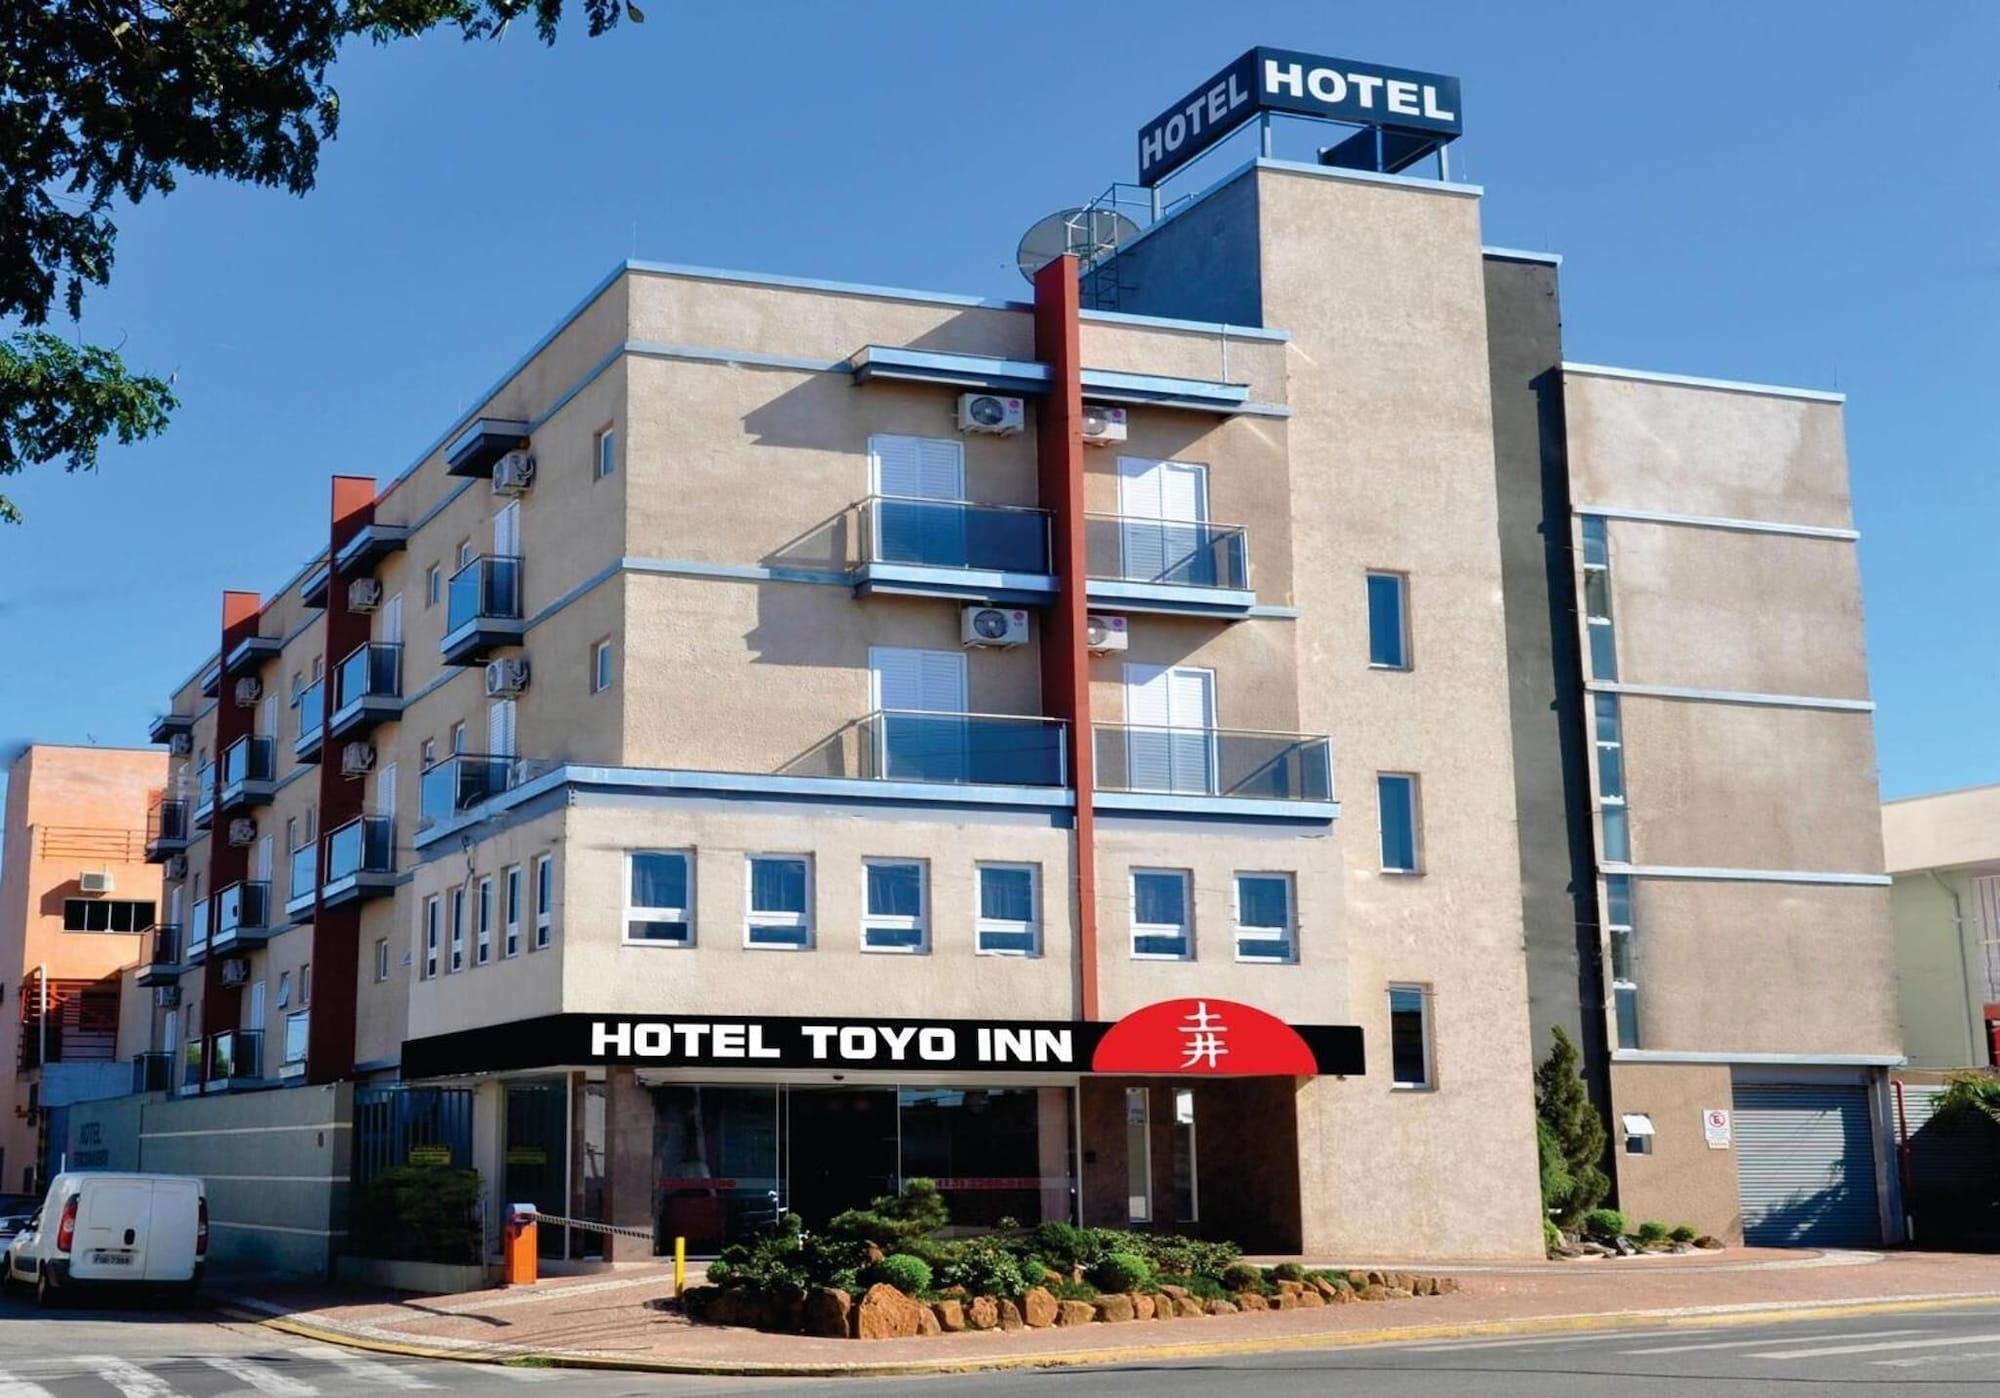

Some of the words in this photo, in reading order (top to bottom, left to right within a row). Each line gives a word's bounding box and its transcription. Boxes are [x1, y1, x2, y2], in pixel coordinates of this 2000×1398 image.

[1141, 73, 1249, 171] HOTEL
[1264, 59, 1455, 122] HOTEL
[591, 1022, 781, 1058] HOTEL
[801, 1025, 957, 1061] TOYO
[978, 1028, 1073, 1063] INN
[1177, 1000, 1229, 1069] 土井
